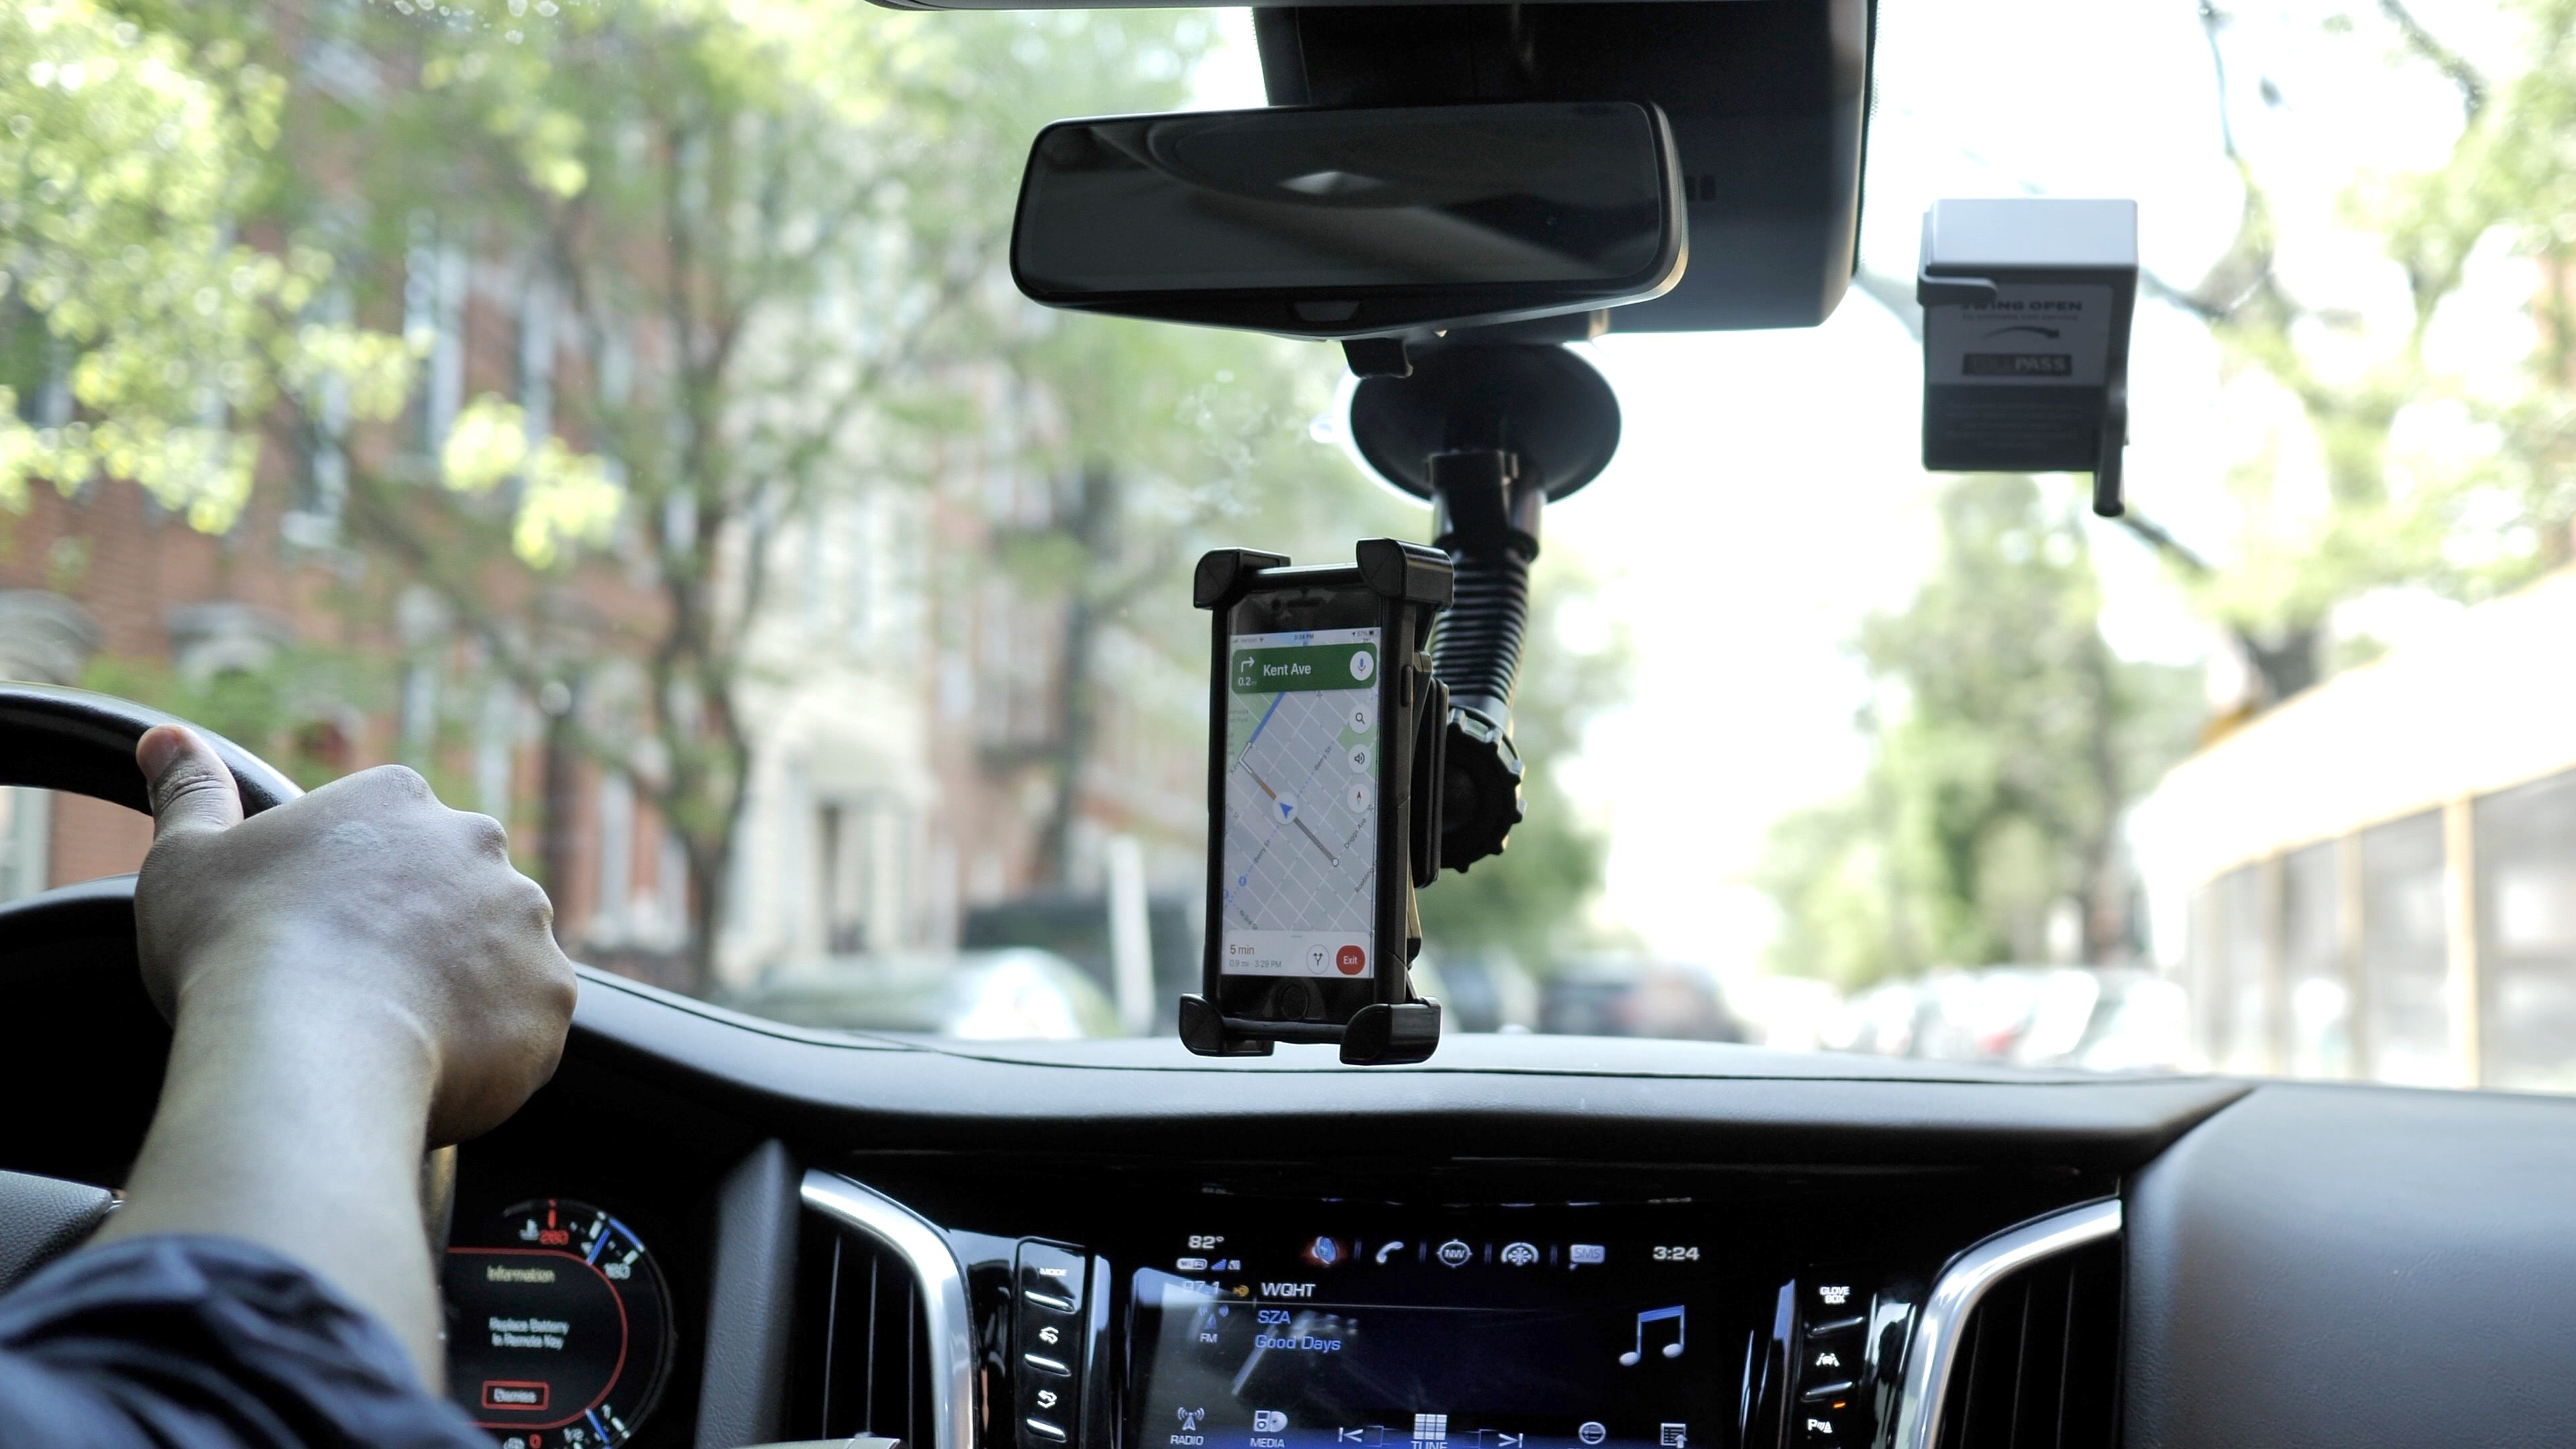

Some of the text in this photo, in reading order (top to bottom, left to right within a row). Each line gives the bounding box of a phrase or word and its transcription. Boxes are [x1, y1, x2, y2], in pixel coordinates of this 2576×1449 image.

[2030, 301, 2082, 311] OPEN
[1264, 663, 1311, 676] Kent Ave
[1238, 677, 1251, 686] 0.2
[1314, 754, 1327, 771] Berry
[1344, 818, 1366, 849] Driggs Ave
[1230, 944, 1254, 955] 5 min
[1229, 959, 1240, 967] 0.9
[1343, 955, 1358, 965] Exit
[1189, 1236, 1224, 1248] 82°
[1445, 1248, 1466, 1258] NW
[1574, 1247, 1600, 1259] SMS
[1653, 1246, 1700, 1260] 3:24
[486, 1265, 555, 1283] Information
[1039, 1267, 1067, 1277] MODE
[1261, 1282, 1316, 1297] WQHT
[1819, 1286, 1850, 1295] GLOVE
[1825, 1295, 1846, 1304] BOX
[1257, 1311, 1291, 1324] SZA
[488, 1316, 570, 1336] Replace Battery
[504, 1332, 543, 1348] Remote
[543, 1334, 565, 1350] Key
[1199, 1332, 1218, 1343] FM
[1254, 1336, 1341, 1353] Good Days
[493, 1387, 537, 1403] Dismiss
[1170, 1434, 1204, 1446] RADIO
[1250, 1437, 1285, 1448] MEDIA
[1411, 1441, 1448, 1449] TUNE
